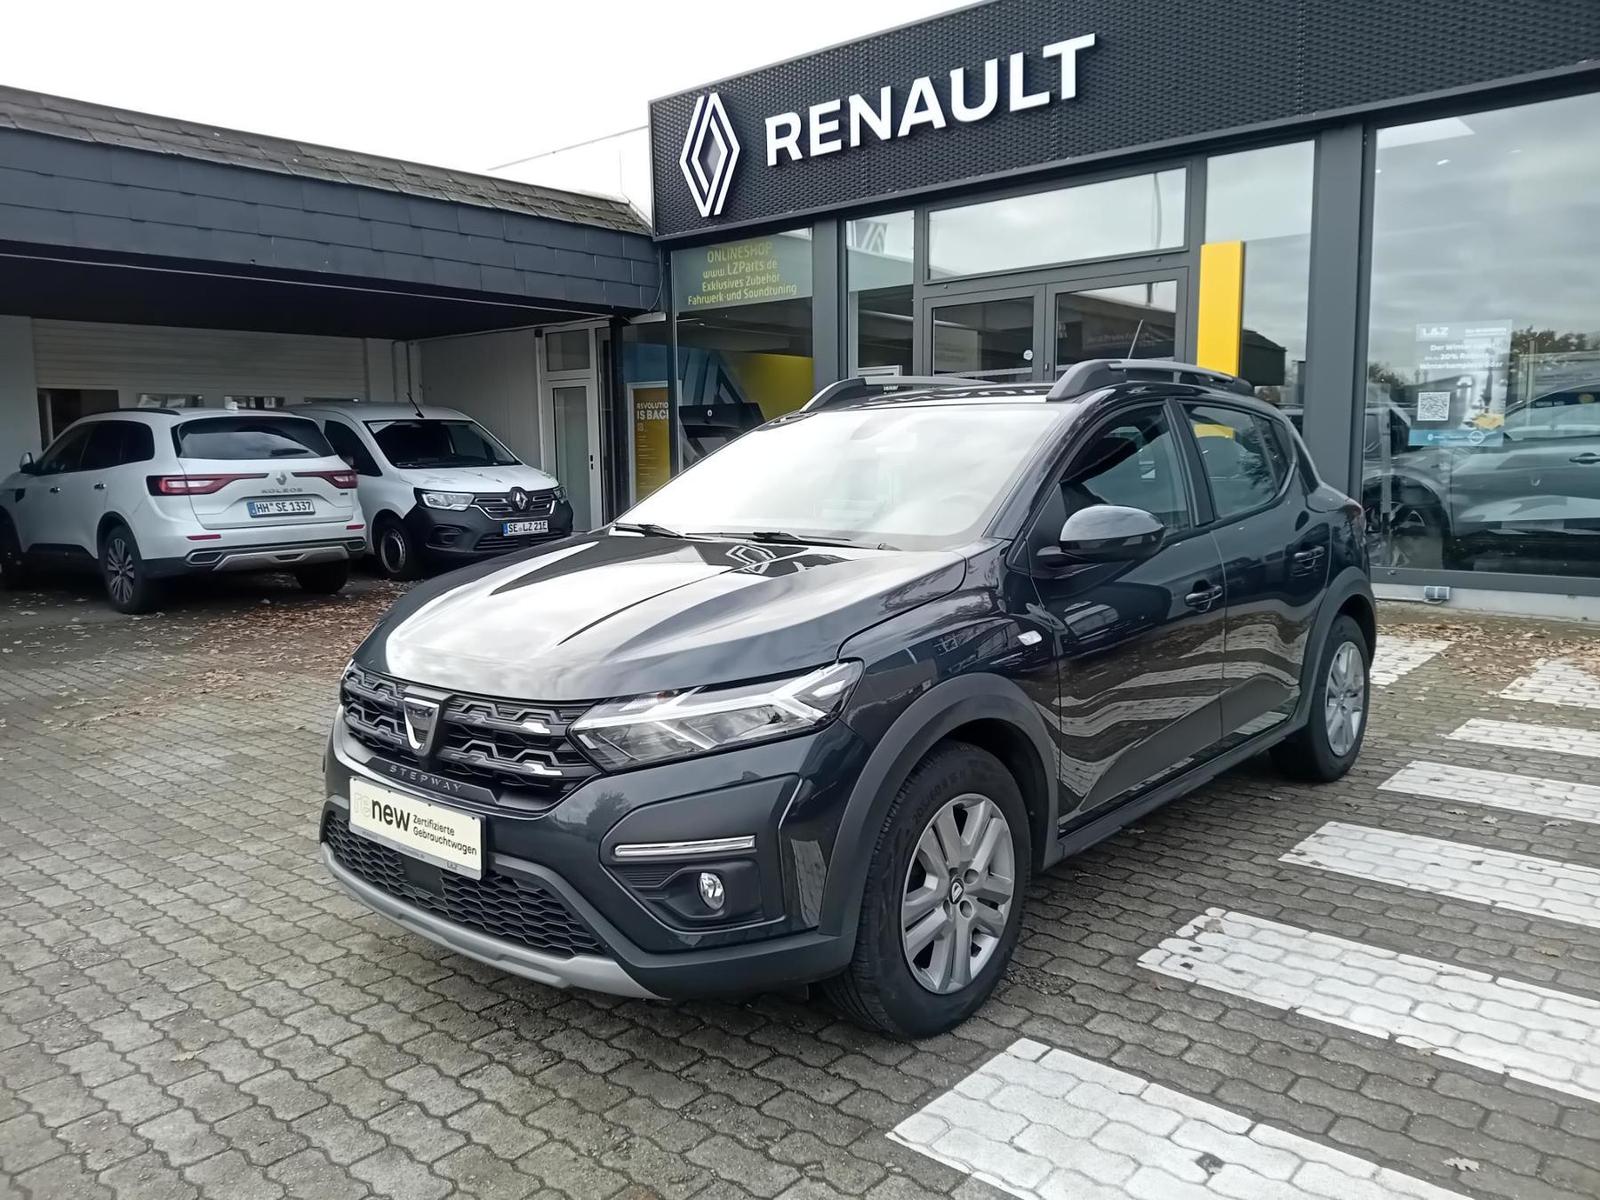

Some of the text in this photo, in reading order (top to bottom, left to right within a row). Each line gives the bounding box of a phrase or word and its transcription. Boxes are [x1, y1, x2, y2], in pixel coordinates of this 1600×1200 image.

[765, 33, 1096, 167] RENAULT
[707, 241, 773, 263] ONLINESHOP
[702, 272, 781, 292] Exklusives Zubehör
[743, 283, 798, 299] Soundtuning
[636, 401, 669, 410] REVOLUTIO
[636, 410, 646, 420] IS
[256, 501, 311, 513] HH SE 1337
[508, 523, 518, 533] SE
[389, 764, 461, 793] STEPWAY
[413, 814, 455, 837] Zertifizierte
[412, 826, 478, 856] Gebrauchtwagen
